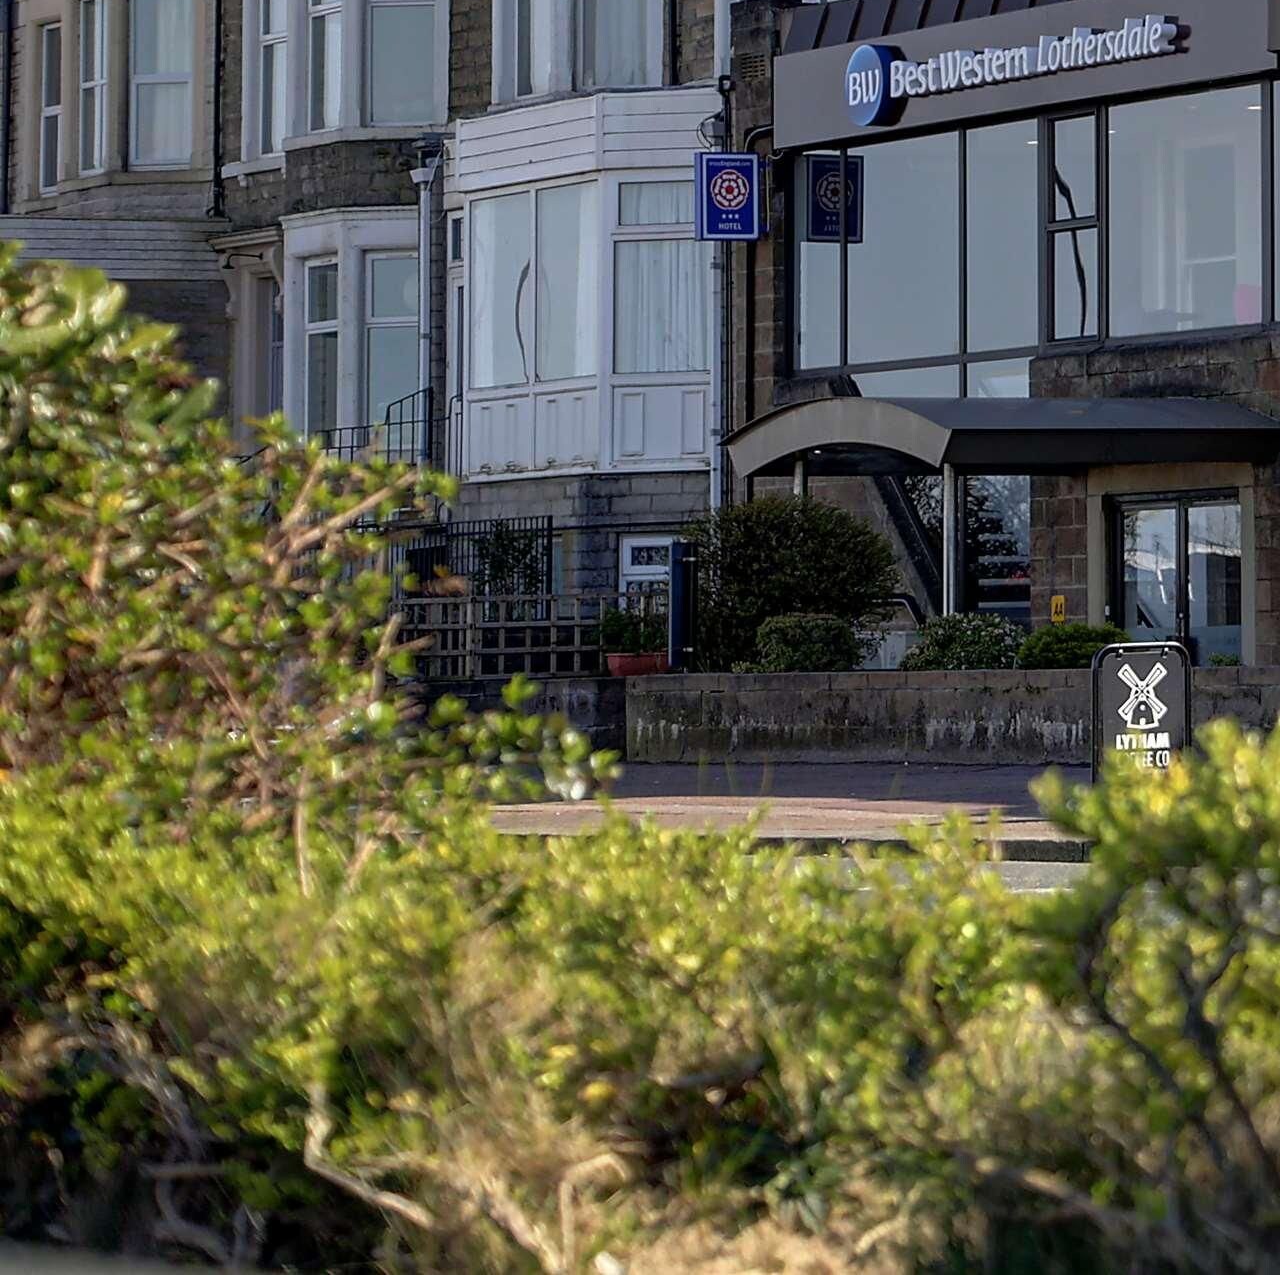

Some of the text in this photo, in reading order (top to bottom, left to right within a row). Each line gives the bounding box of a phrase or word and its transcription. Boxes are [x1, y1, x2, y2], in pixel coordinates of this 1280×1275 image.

[848, 17, 1164, 106] BW Best Western Lothersdale
[718, 222, 742, 230] HOTEL
[1115, 732, 1171, 750] LYTHAM
